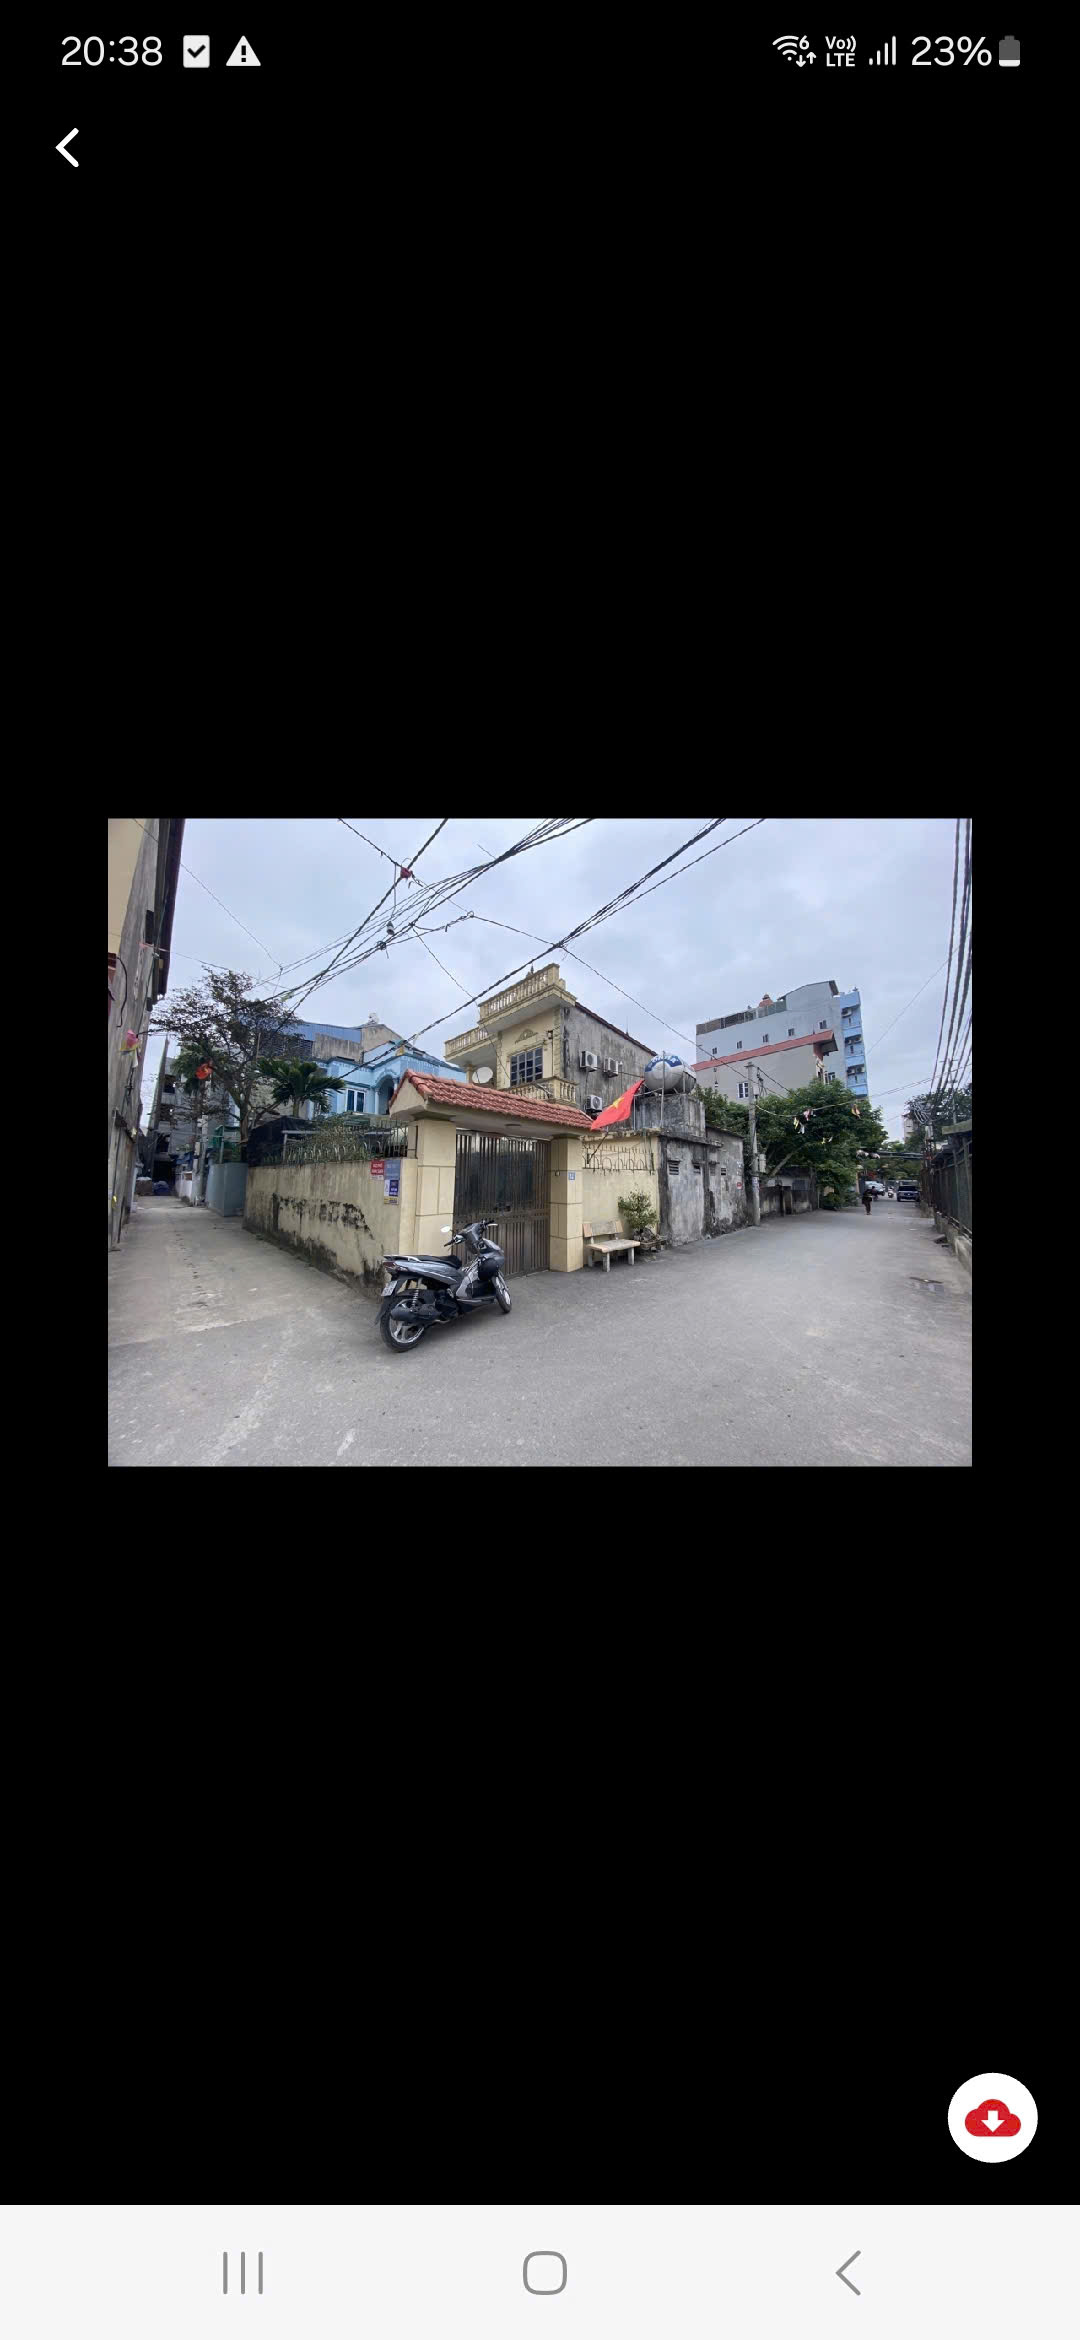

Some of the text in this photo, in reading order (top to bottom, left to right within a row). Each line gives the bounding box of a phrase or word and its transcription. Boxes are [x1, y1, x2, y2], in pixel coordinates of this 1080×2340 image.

[61, 35, 163, 67] 20:38
[826, 52, 856, 67] LTE
[911, 35, 993, 67] 23%
